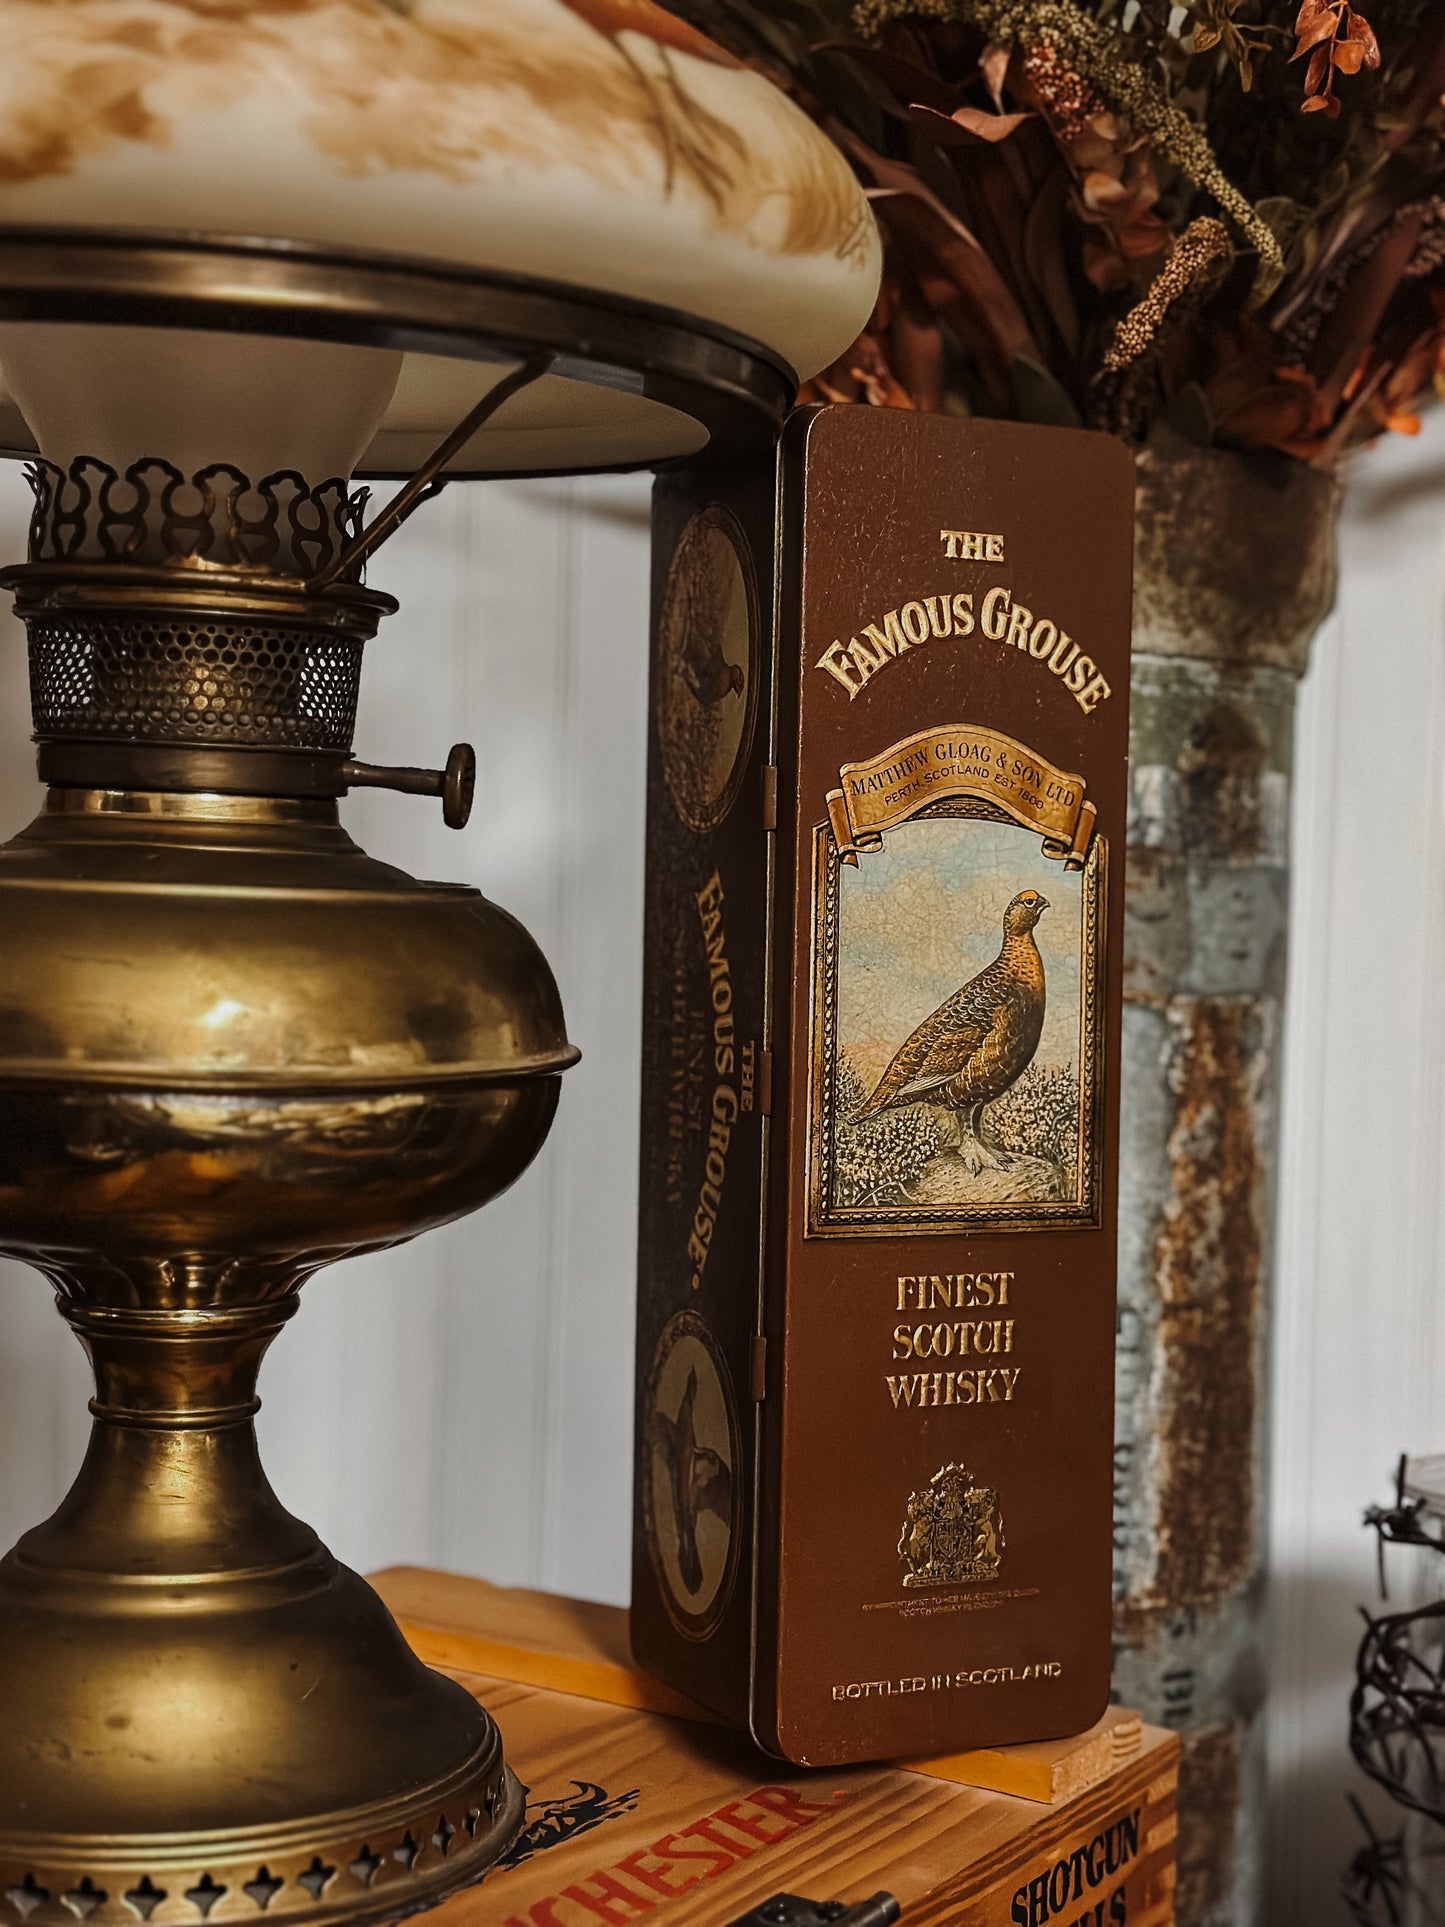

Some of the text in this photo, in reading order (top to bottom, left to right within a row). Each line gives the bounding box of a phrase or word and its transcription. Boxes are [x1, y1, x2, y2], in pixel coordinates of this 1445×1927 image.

[940, 529, 1004, 562] THE
[814, 587, 1112, 715] FAMOUS GROUSE
[850, 742, 1076, 807] MATTHEW GLOAG & SON LTD
[923, 765, 990, 783] SCOTLAND
[994, 773, 1017, 790] EST
[1018, 787, 1044, 810] 1800
[695, 866, 735, 1075] FAMOUS
[741, 1040, 755, 1112] THE
[896, 1272, 1015, 1311] FINEST
[892, 1319, 1016, 1360] SCOTCH
[884, 1367, 1022, 1409] WHISKY
[832, 1661, 1062, 1701] BOTTLED IN SCOTLAND
[1011, 1808, 1141, 1927] SHOTGUN
